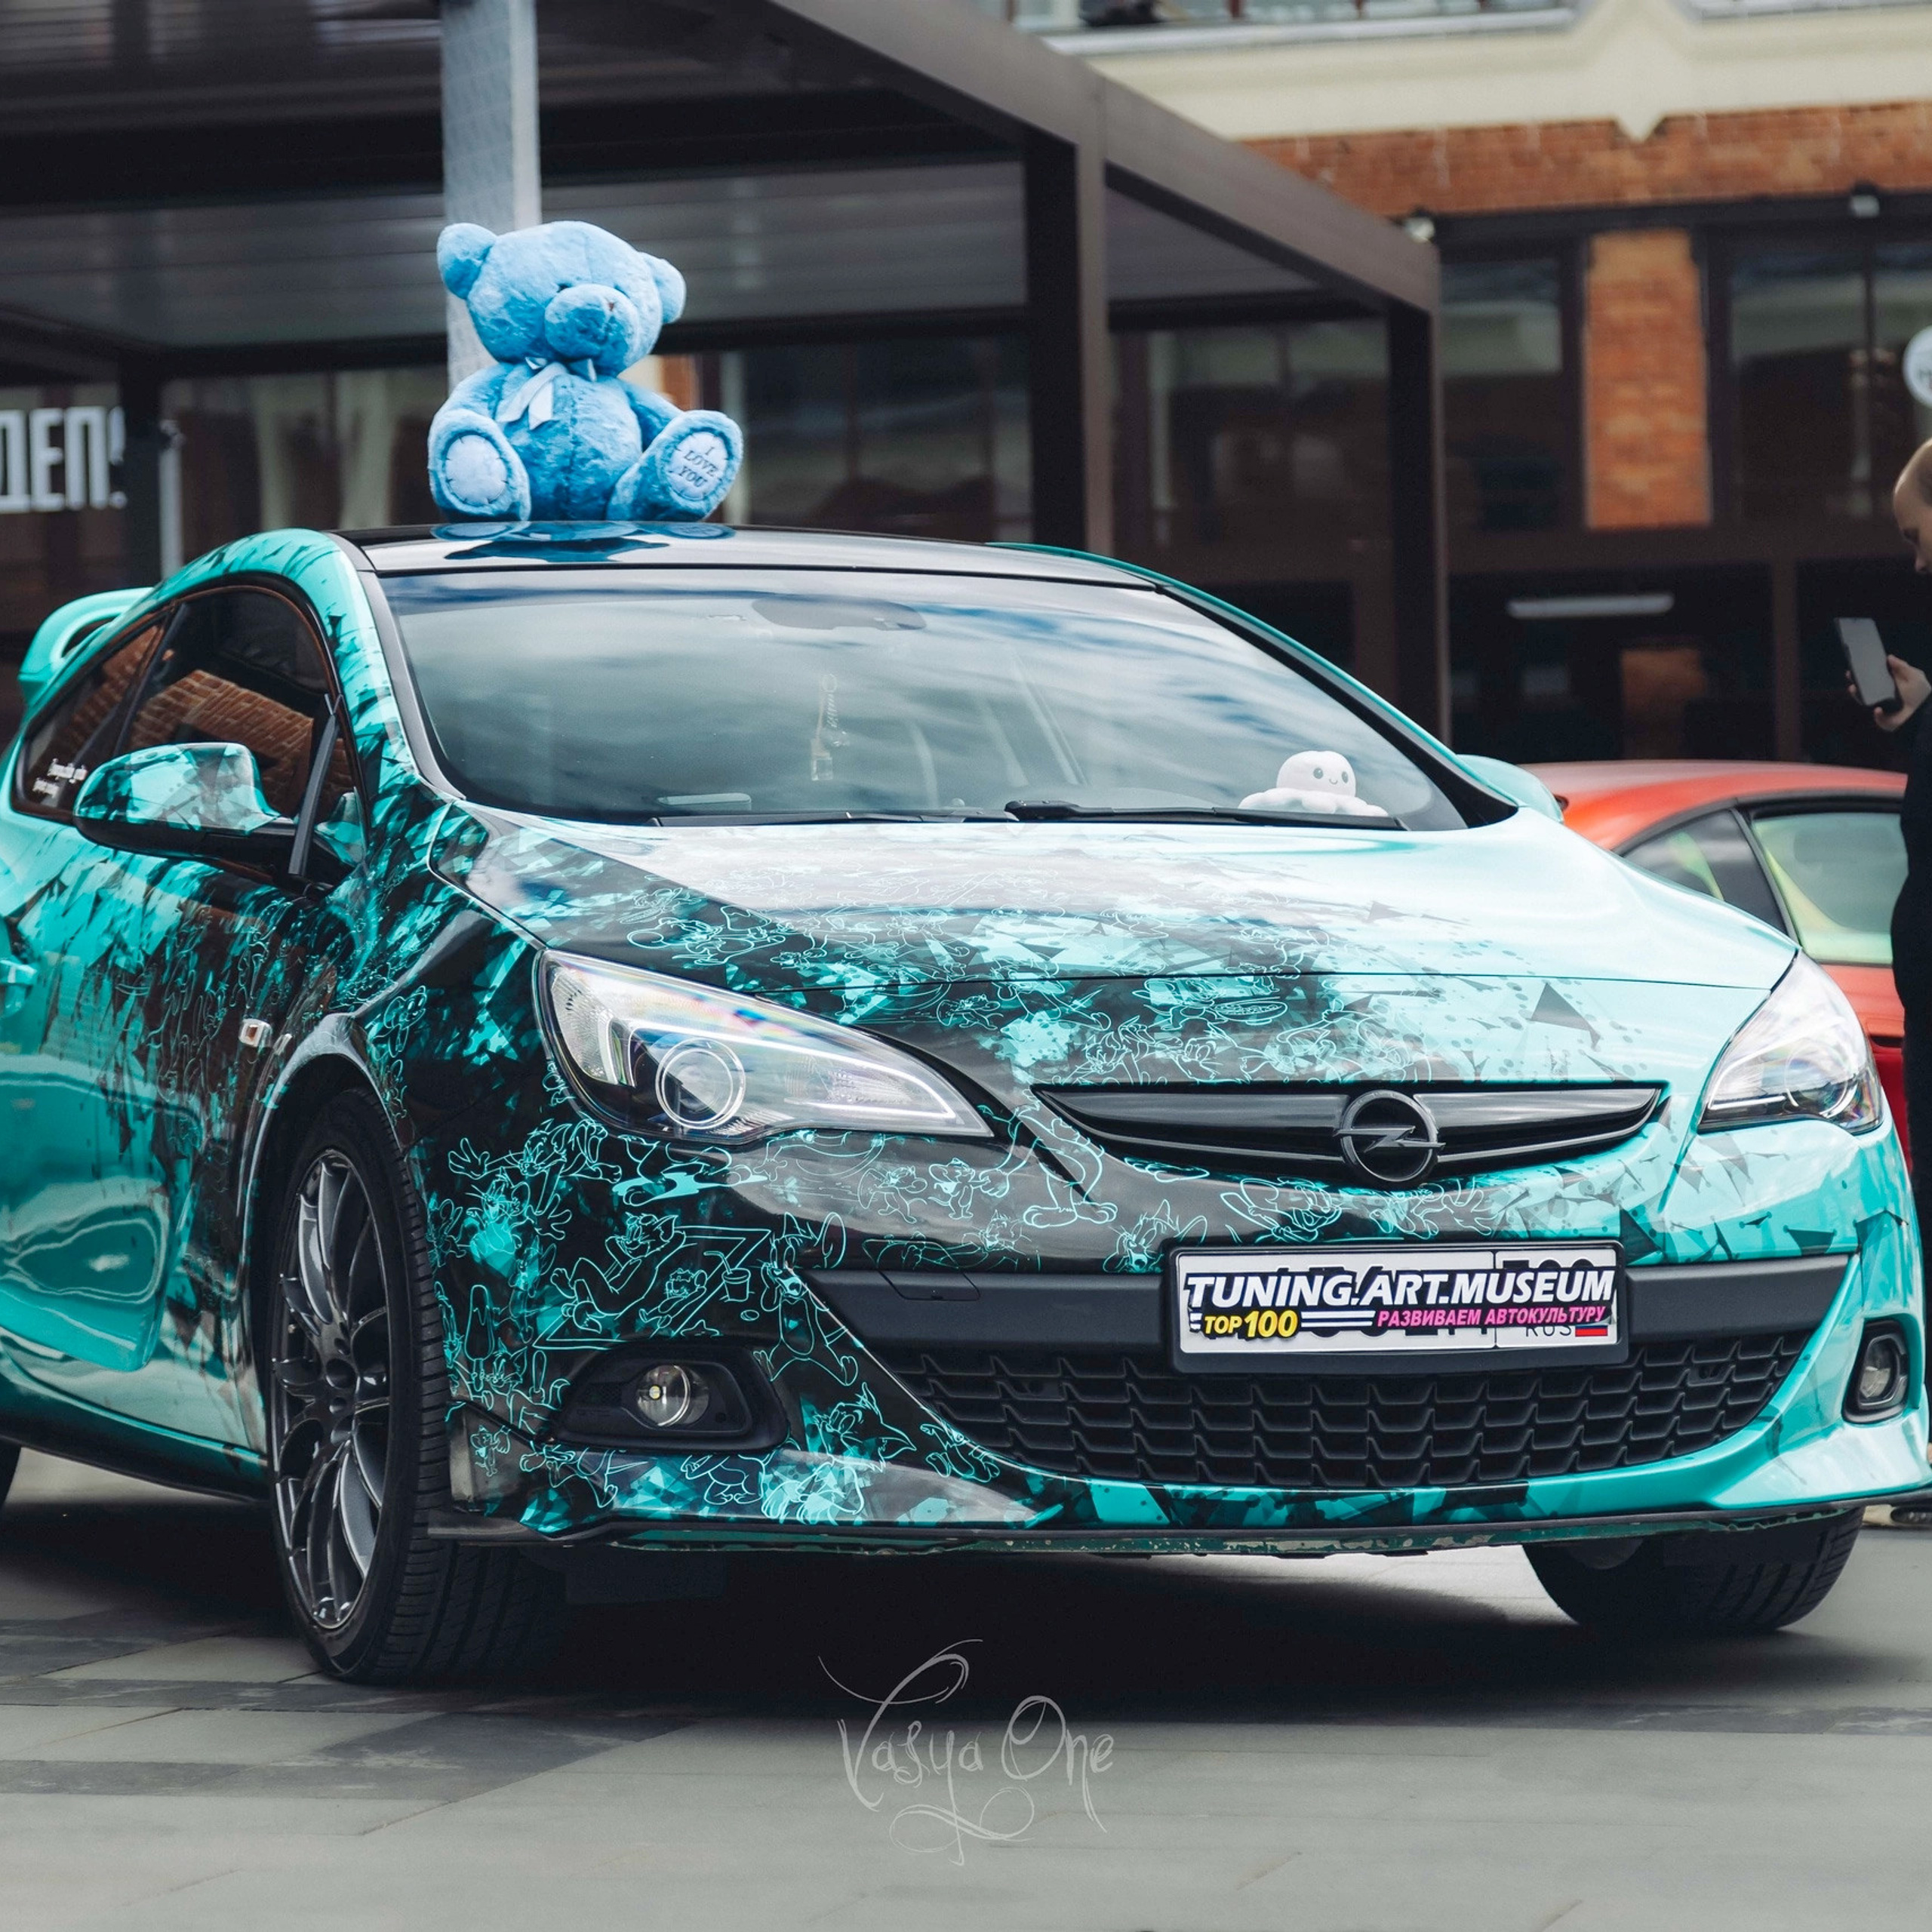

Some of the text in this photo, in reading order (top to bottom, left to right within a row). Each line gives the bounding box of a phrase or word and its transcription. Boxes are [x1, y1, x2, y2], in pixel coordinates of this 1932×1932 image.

[705, 447, 715, 456] I
[684, 450, 718, 478] LOVE
[678, 466, 708, 488] YOU
[1377, 1306, 1607, 1327] РАЗВИВАЕМ АВТОКУЛЬТУРУ
